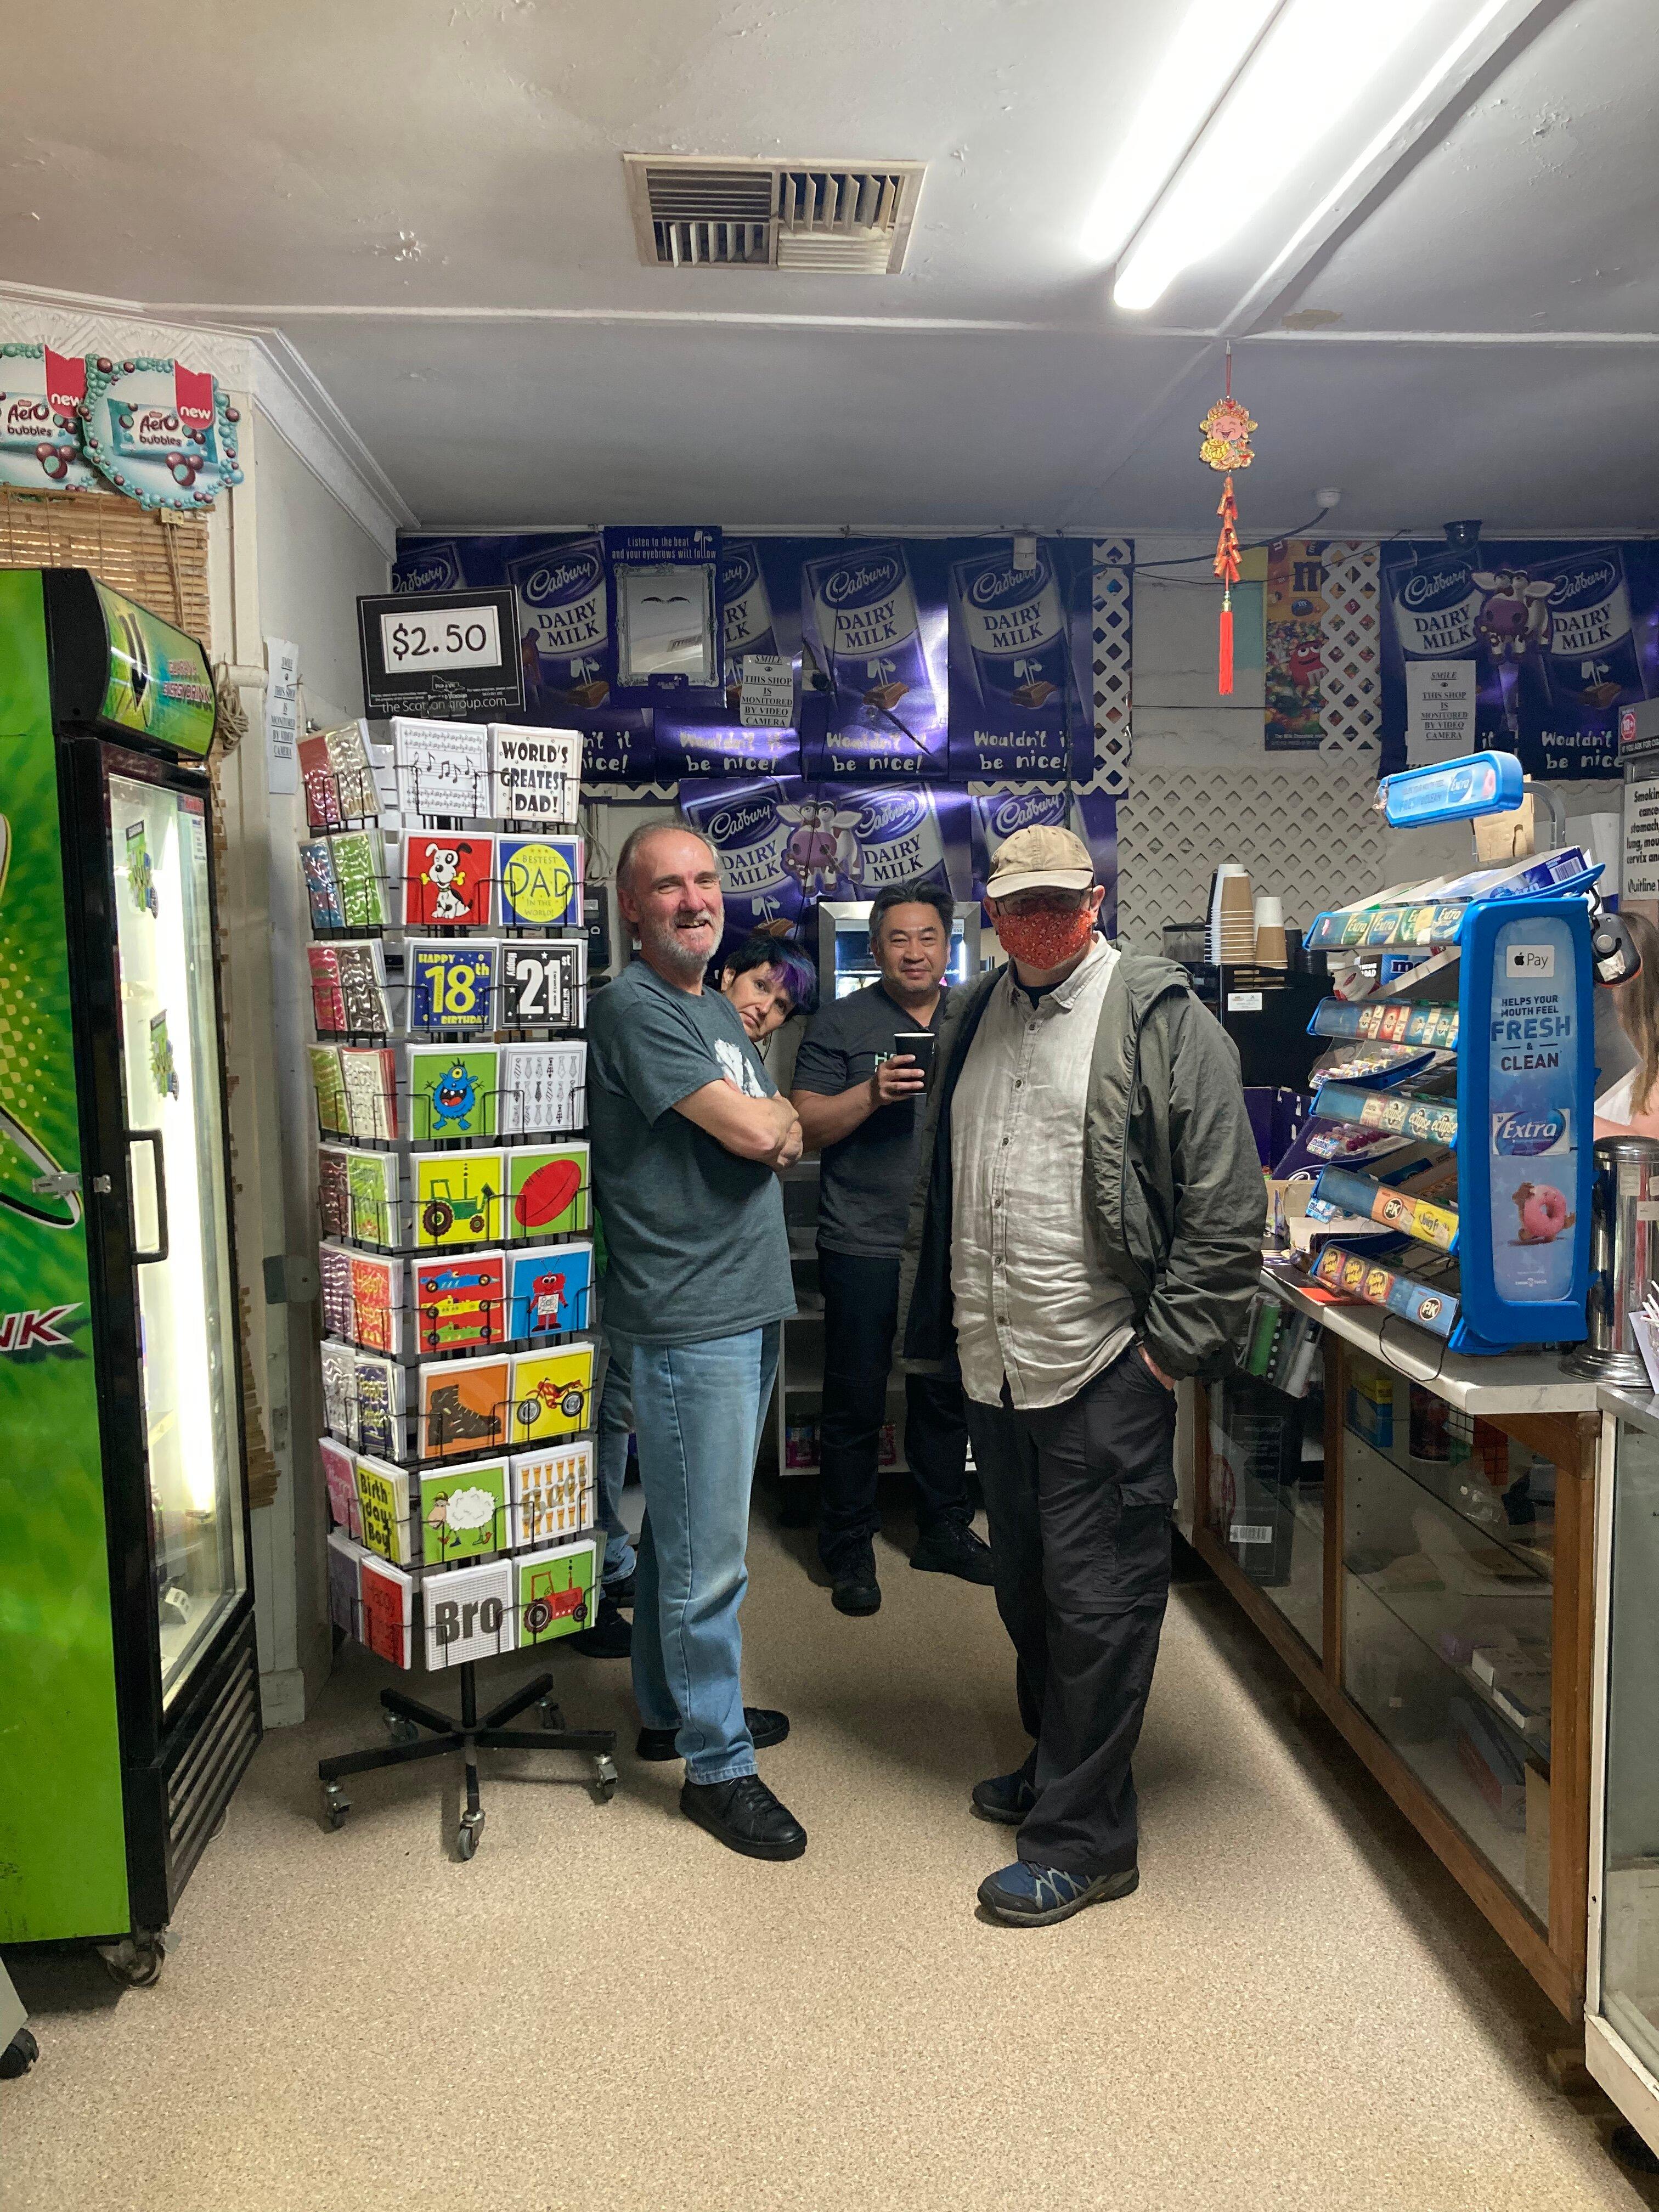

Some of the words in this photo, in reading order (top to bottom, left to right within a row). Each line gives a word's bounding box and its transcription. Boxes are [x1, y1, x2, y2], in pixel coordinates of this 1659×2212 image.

[180, 405, 211, 420] new
[7, 425, 52, 437] bubbles
[139, 435, 182, 447] bubbles
[628, 536, 650, 548] Listen
[652, 537, 659, 547] to
[661, 536, 672, 547] the
[674, 536, 689, 547] beat
[612, 549, 624, 560] and
[626, 550, 641, 560] your
[642, 549, 675, 560] eyebrows
[678, 548, 692, 559] will
[694, 548, 716, 559] follow
[526, 562, 591, 601] Cadbury
[826, 565, 891, 602] Cadbury
[973, 569, 1036, 603] Cadbury
[1404, 568, 1466, 605] Cadbury
[537, 598, 597, 630] DAIRY
[837, 600, 896, 630] DAIRY
[983, 601, 1041, 630] DAIRY
[1414, 604, 1471, 633] DAIRY
[1554, 604, 1612, 633] DAIRY
[393, 622, 486, 659] $2.50
[547, 620, 601, 647] MILK
[725, 622, 751, 642] LK
[845, 621, 898, 648] MILK
[992, 622, 1043, 648] MILK
[1423, 624, 1472, 650] MILK
[1561, 624, 1612, 650] MILK
[755, 654, 782, 664] SMILE
[745, 675, 766, 684] THIS
[768, 676, 792, 685] SHOP
[187, 684, 212, 704] DRINK
[742, 696, 792, 706] MONITORED
[1444, 692, 1466, 700] SHOP
[383, 701, 400, 713] the
[403, 700, 445, 712] Scoton
[759, 707, 788, 715] VIDEO
[746, 716, 785, 726] CAMERA
[827, 732, 900, 751] Wouldn't
[974, 730, 1047, 748] Wouldn't
[1482, 731, 1494, 750] it
[1541, 730, 1612, 748] Wouldn't
[501, 741, 568, 764] WORLD'S
[981, 754, 1003, 770] be
[1016, 750, 1068, 771] nice!
[1546, 753, 1568, 769] be
[686, 755, 711, 771] be
[723, 752, 778, 774] nice!
[832, 755, 856, 771] be
[869, 752, 923, 774] nice!
[500, 767, 567, 791] GREATEST
[515, 793, 557, 813] DAD!
[997, 792, 1060, 833] Cadbury
[1639, 805, 1659, 818] cance
[708, 805, 770, 843] Cadbury
[722, 840, 777, 870] DAIRY
[863, 834, 921, 864] DAIRY
[523, 855, 558, 864] BESTEST
[873, 854, 923, 882] MILK
[509, 862, 570, 897] DAD
[729, 860, 780, 887] MILK
[1628, 878, 1655, 894] Quitline
[419, 953, 455, 963] HAPPY
[1527, 953, 1549, 969] Pay
[1501, 1007, 1533, 1017] MOUTH
[1536, 1005, 1559, 1014] FEEL
[1502, 996, 1531, 1007] HELPS
[1533, 995, 1558, 1004] YOUR
[441, 1015, 488, 1024] BIRTHDAY
[1491, 1015, 1571, 1042] FRESH
[1501, 1052, 1559, 1071] CLEAN
[1502, 1120, 1557, 1139] Extra
[435, 1597, 503, 1646] Bro
